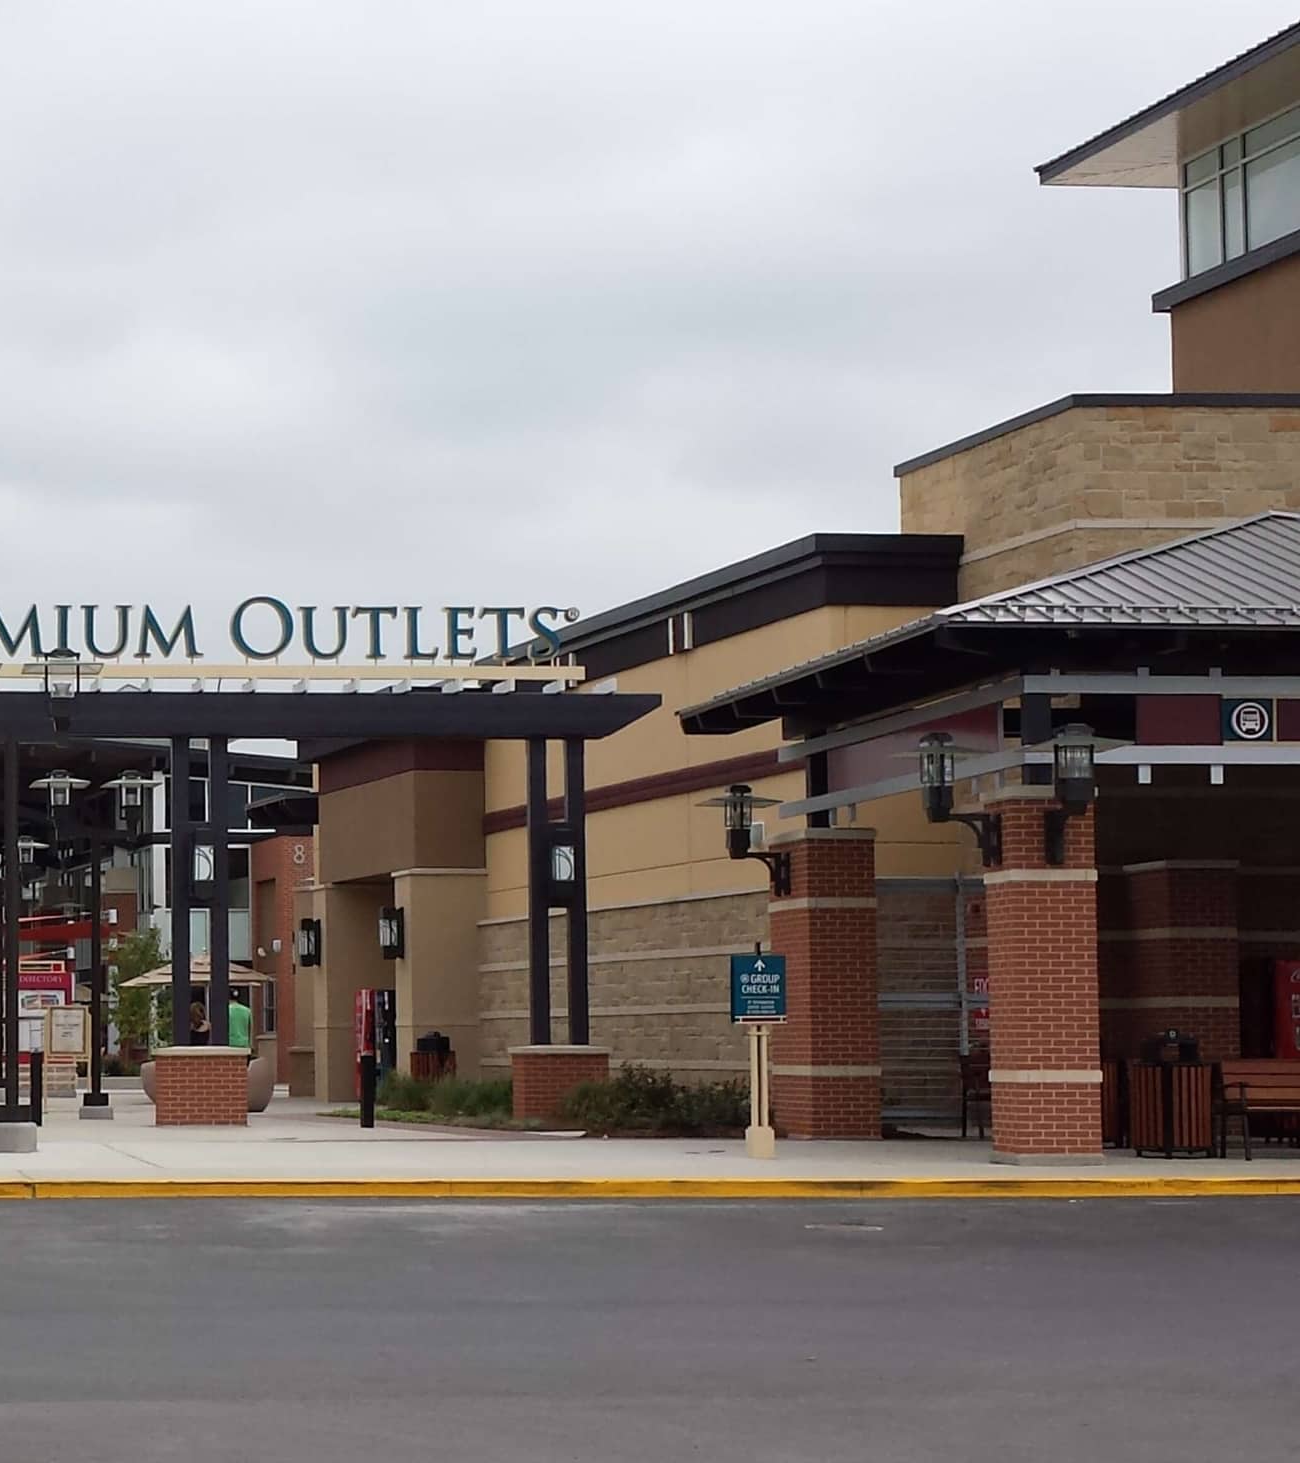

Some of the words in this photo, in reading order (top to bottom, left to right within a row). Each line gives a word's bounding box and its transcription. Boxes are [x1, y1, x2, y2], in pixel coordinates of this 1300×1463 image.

[293, 844, 305, 864] 8
[19, 974, 63, 983] DIRECTORY
[750, 973, 780, 984] GROUP
[741, 984, 780, 994] CHECK-IN
